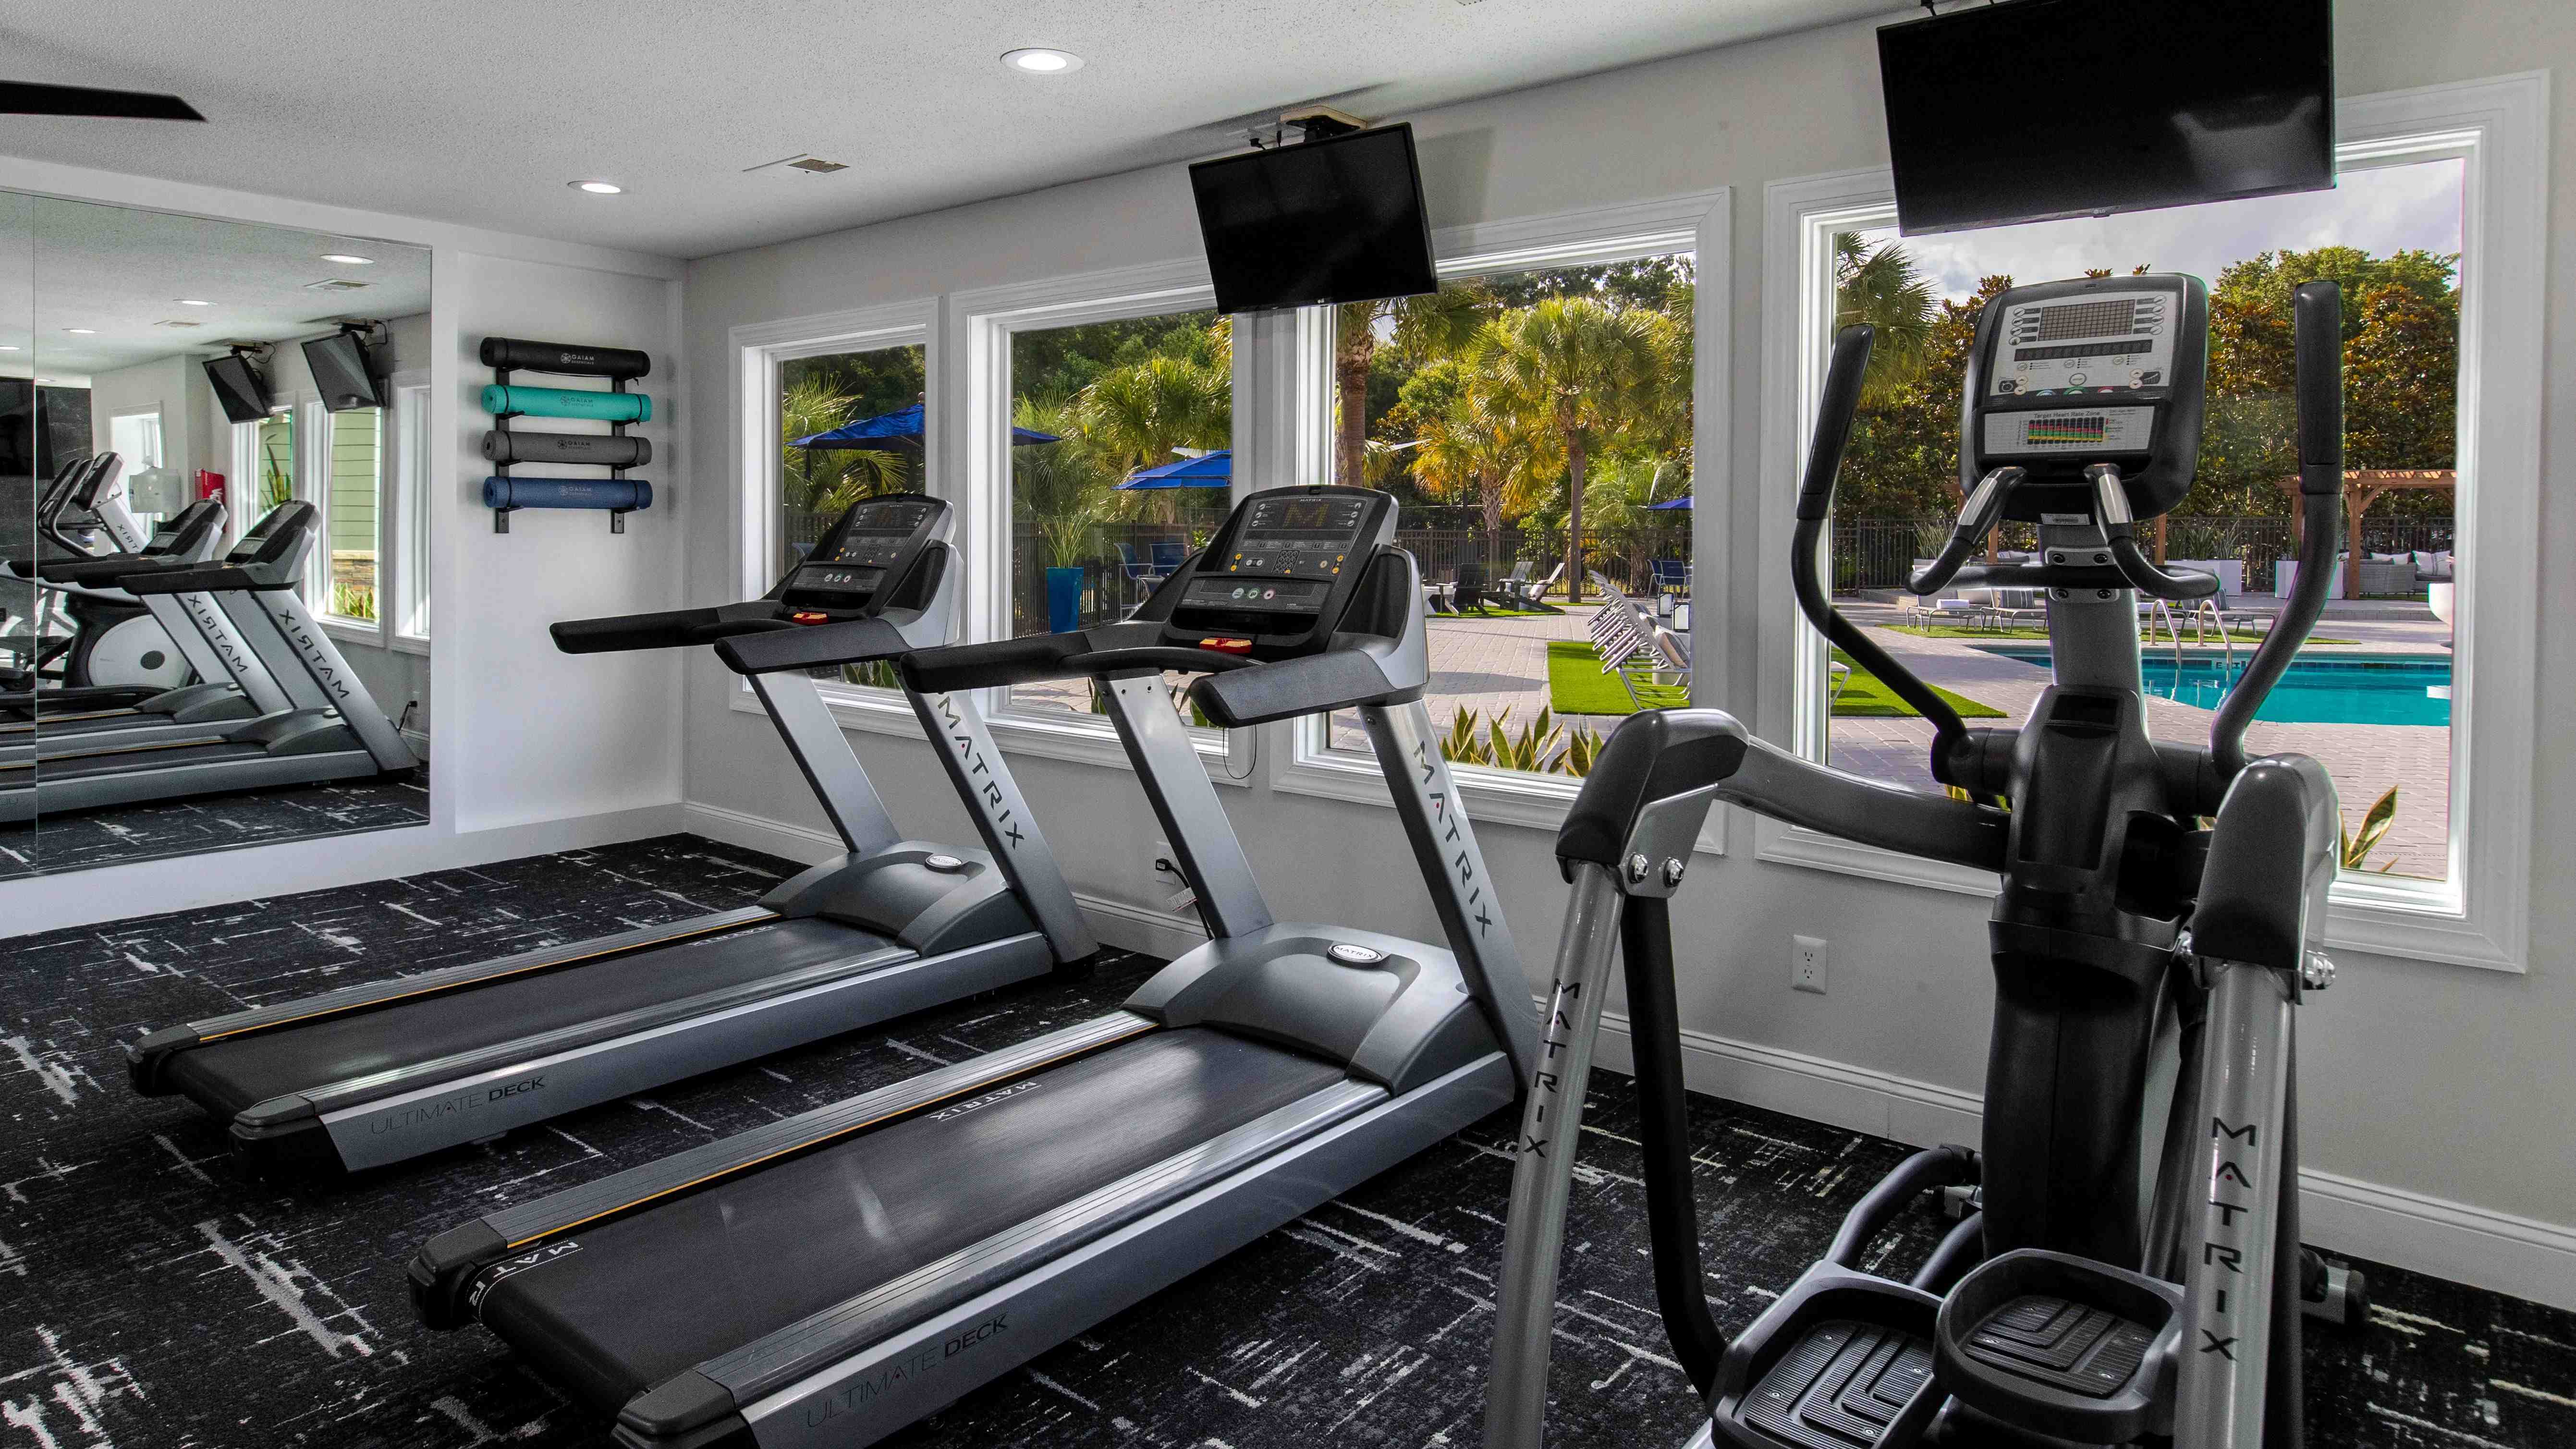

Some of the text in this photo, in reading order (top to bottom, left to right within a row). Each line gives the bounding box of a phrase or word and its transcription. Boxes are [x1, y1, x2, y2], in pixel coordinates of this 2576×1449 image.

[937, 696, 1025, 850] MATRIX
[1414, 740, 1492, 940] MATRIX
[1335, 946, 1374, 959] MATRIX
[371, 1077, 545, 1134] ULTIMATE DECK
[929, 1081, 1038, 1120] MATRIX
[1523, 978, 1581, 1158] MATRIX
[2198, 1117, 2257, 1362] MATRIX
[807, 1313, 1009, 1428] ULTIMATE DECK
